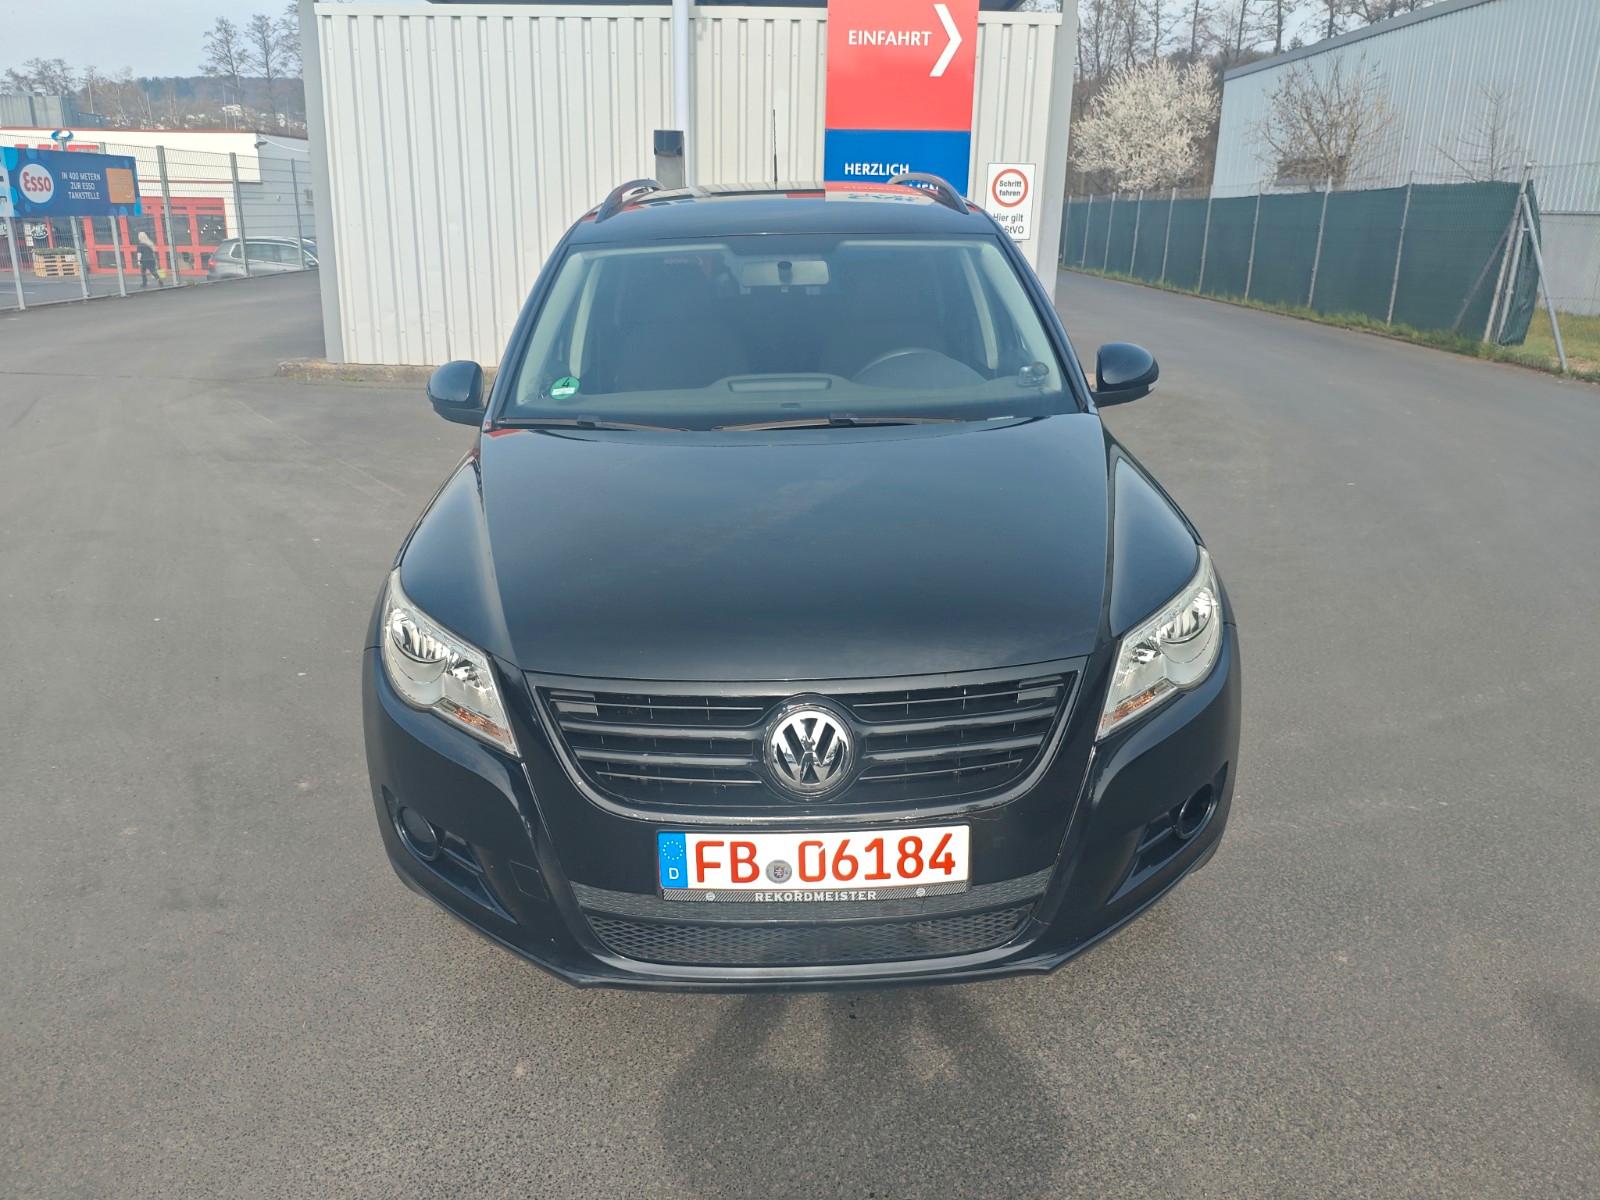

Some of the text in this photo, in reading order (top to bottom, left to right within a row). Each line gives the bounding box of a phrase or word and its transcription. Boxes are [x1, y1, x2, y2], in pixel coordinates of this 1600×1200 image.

[847, 29, 932, 46] EINFAHRT
[844, 162, 910, 176] HERZLICH
[61, 171, 68, 180] IN
[79, 172, 101, 181] METERN
[70, 181, 95, 190] ZUR ESSO
[68, 191, 100, 199] TANKSTELLE
[993, 213, 1023, 224] Hier gilt
[561, 377, 570, 388] 4
[695, 833, 956, 884] FB 06184
[668, 867, 680, 880] D
[754, 890, 877, 903] REKORDMEISTER
